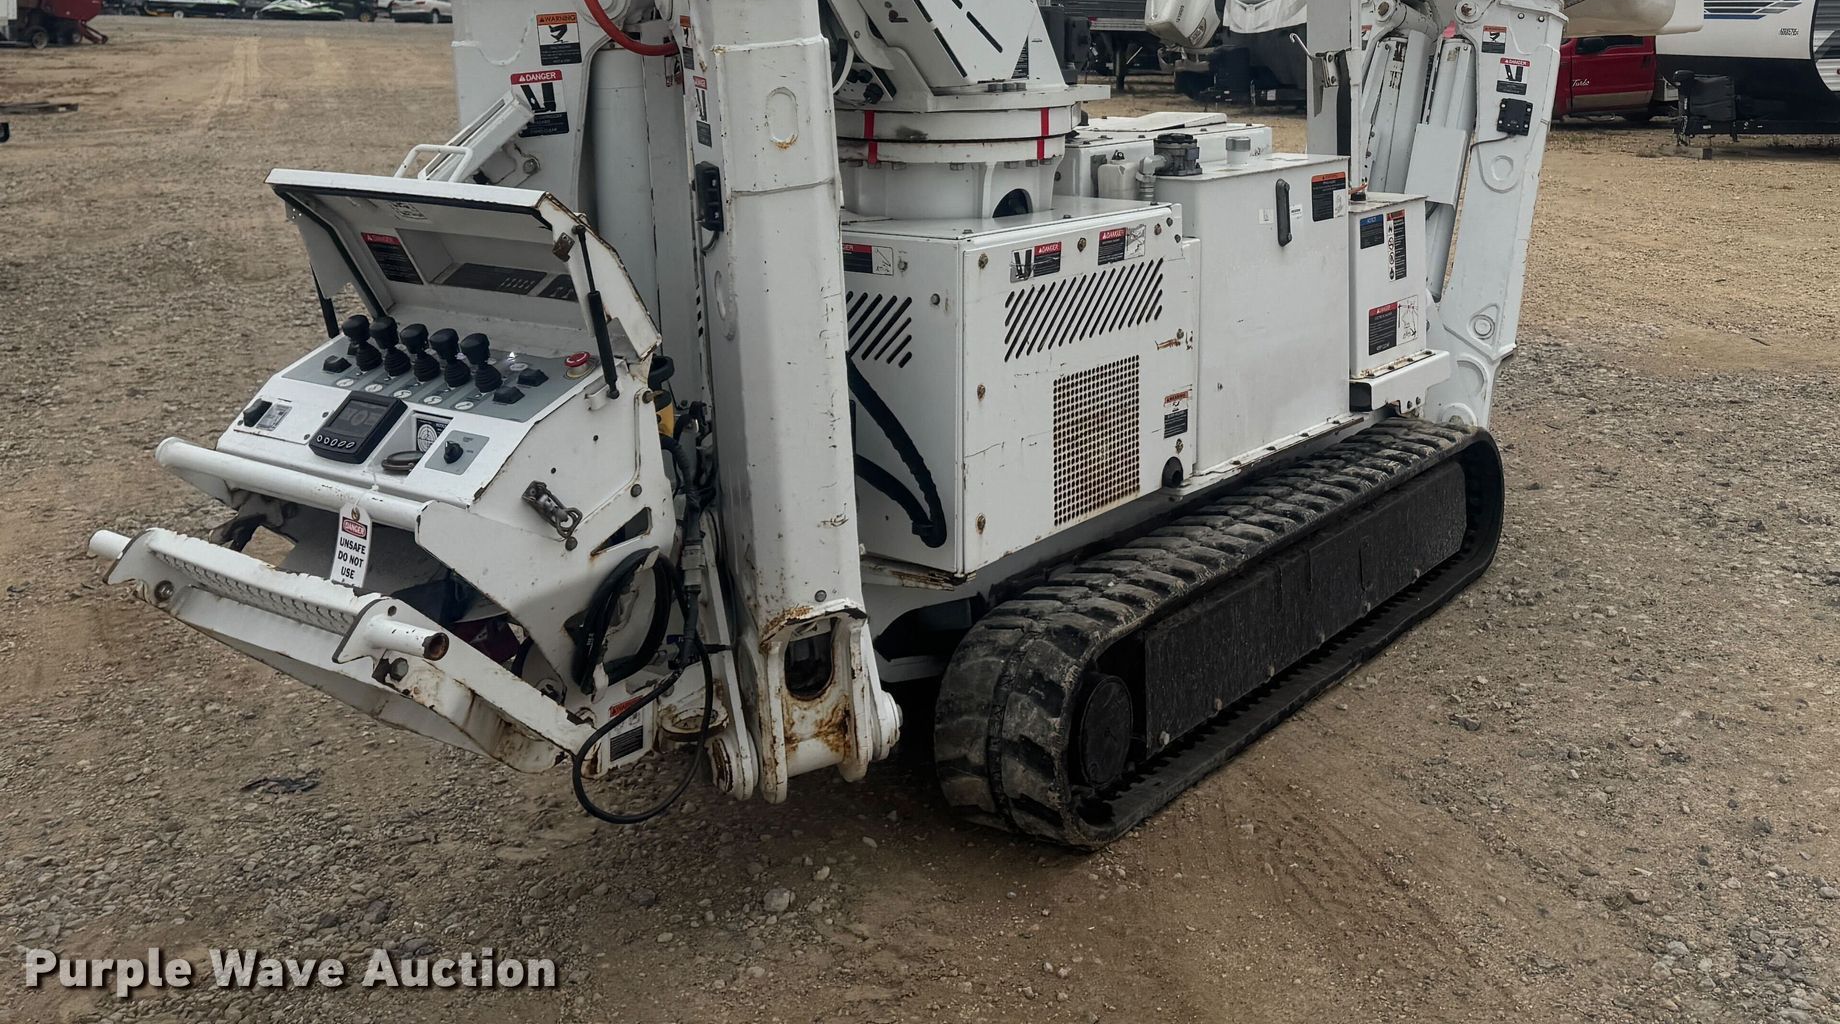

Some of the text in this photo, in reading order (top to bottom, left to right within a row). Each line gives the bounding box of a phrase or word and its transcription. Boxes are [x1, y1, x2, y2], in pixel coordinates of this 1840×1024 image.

[544, 14, 576, 23] WARNING
[525, 71, 556, 81] DANGER
[1571, 78, 1591, 88] Turbo
[1107, 229, 1125, 239] DANGER
[1041, 244, 1059, 253] DANGER
[345, 521, 365, 535] DANGER
[340, 537, 366, 555] UNSAFE
[337, 550, 364, 568] DO NOT
[341, 566, 355, 580] USE
